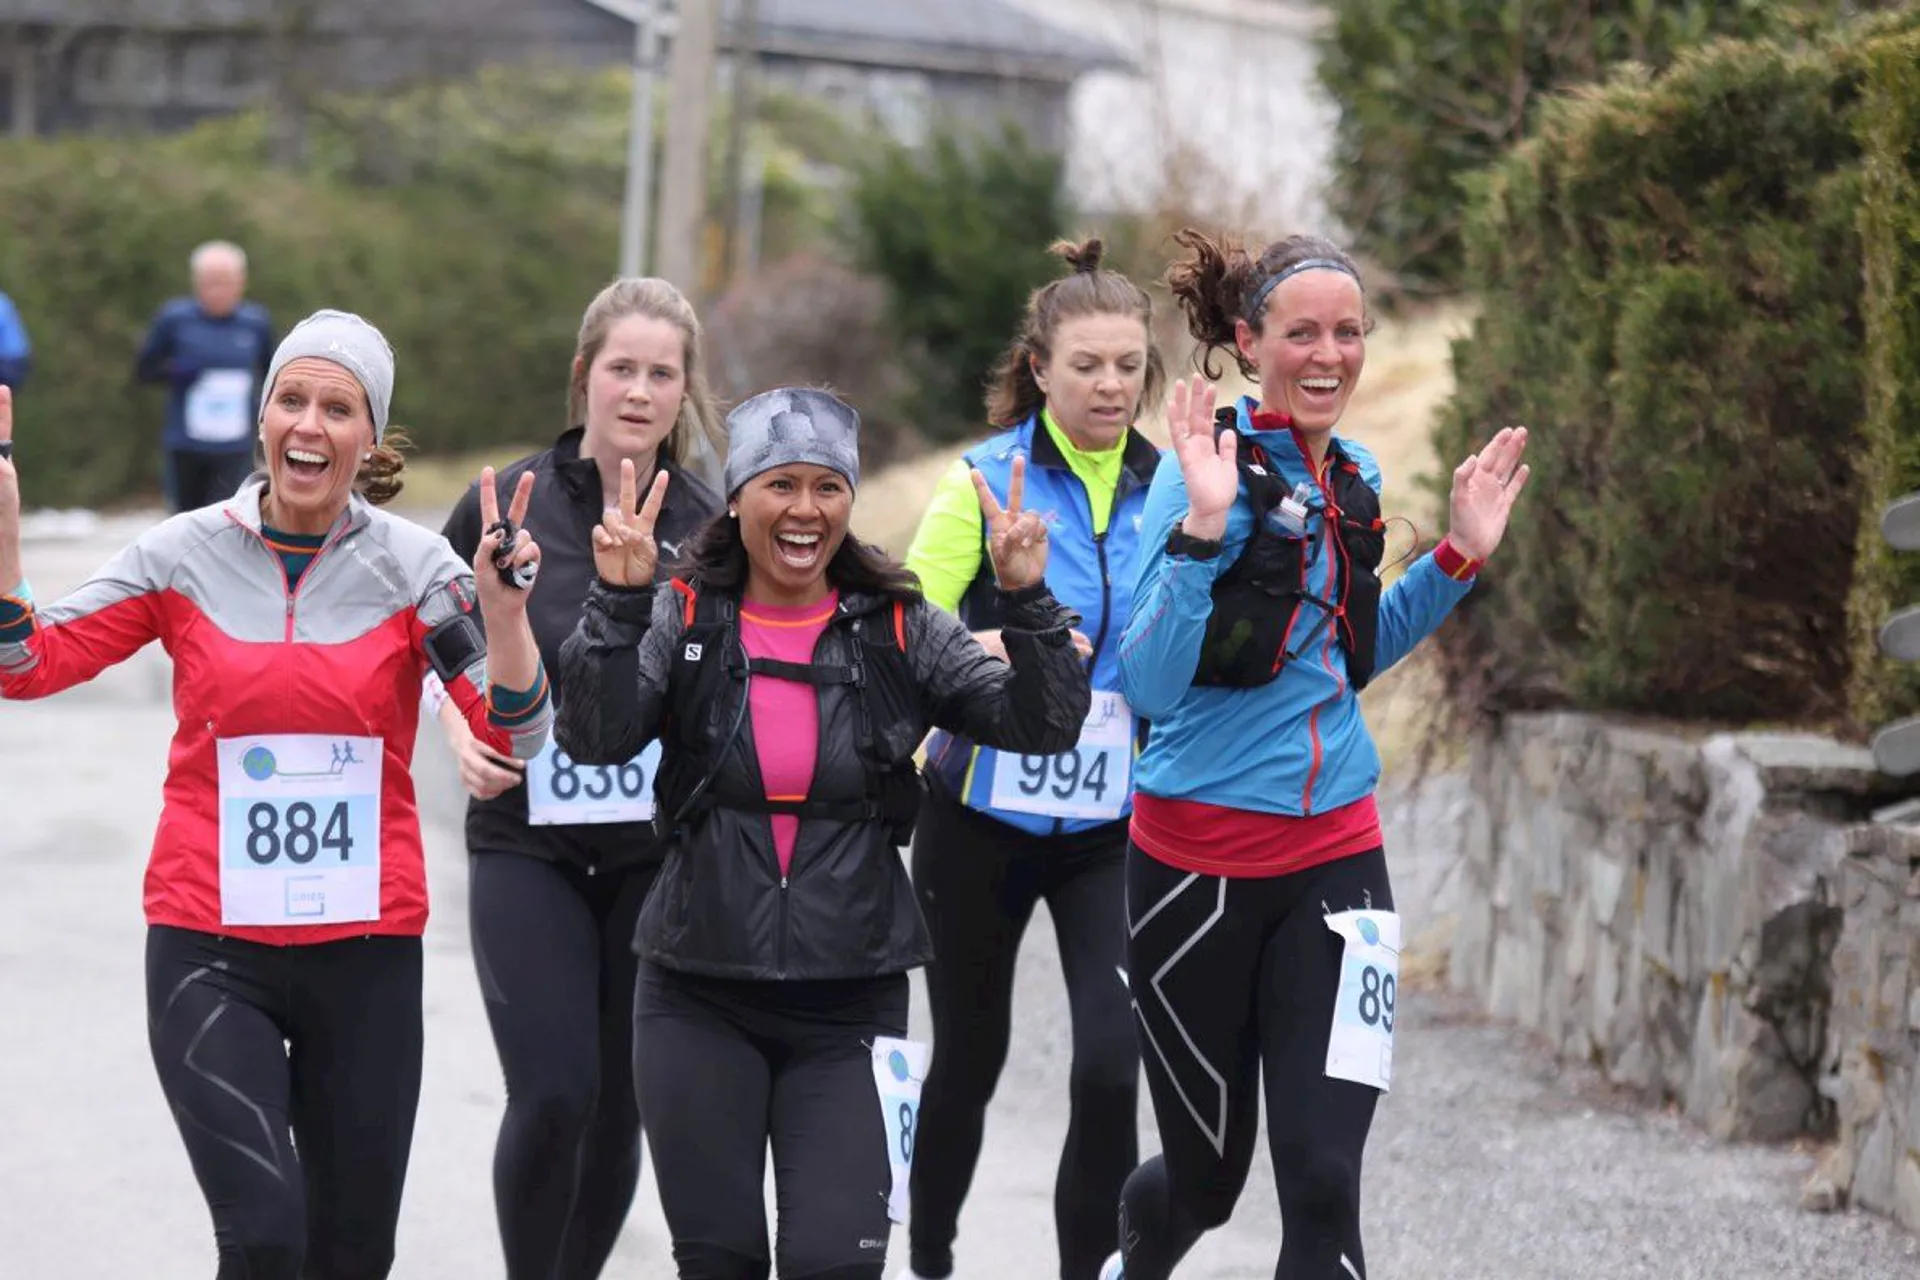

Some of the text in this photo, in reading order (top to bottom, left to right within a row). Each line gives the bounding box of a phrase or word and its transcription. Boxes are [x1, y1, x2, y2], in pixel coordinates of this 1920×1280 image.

[687, 645, 700, 659] S
[551, 747, 644, 800] 836
[1018, 748, 1107, 801] 994
[246, 801, 353, 865] 884
[1359, 965, 1395, 1033] 89
[899, 1102, 917, 1164] 8
